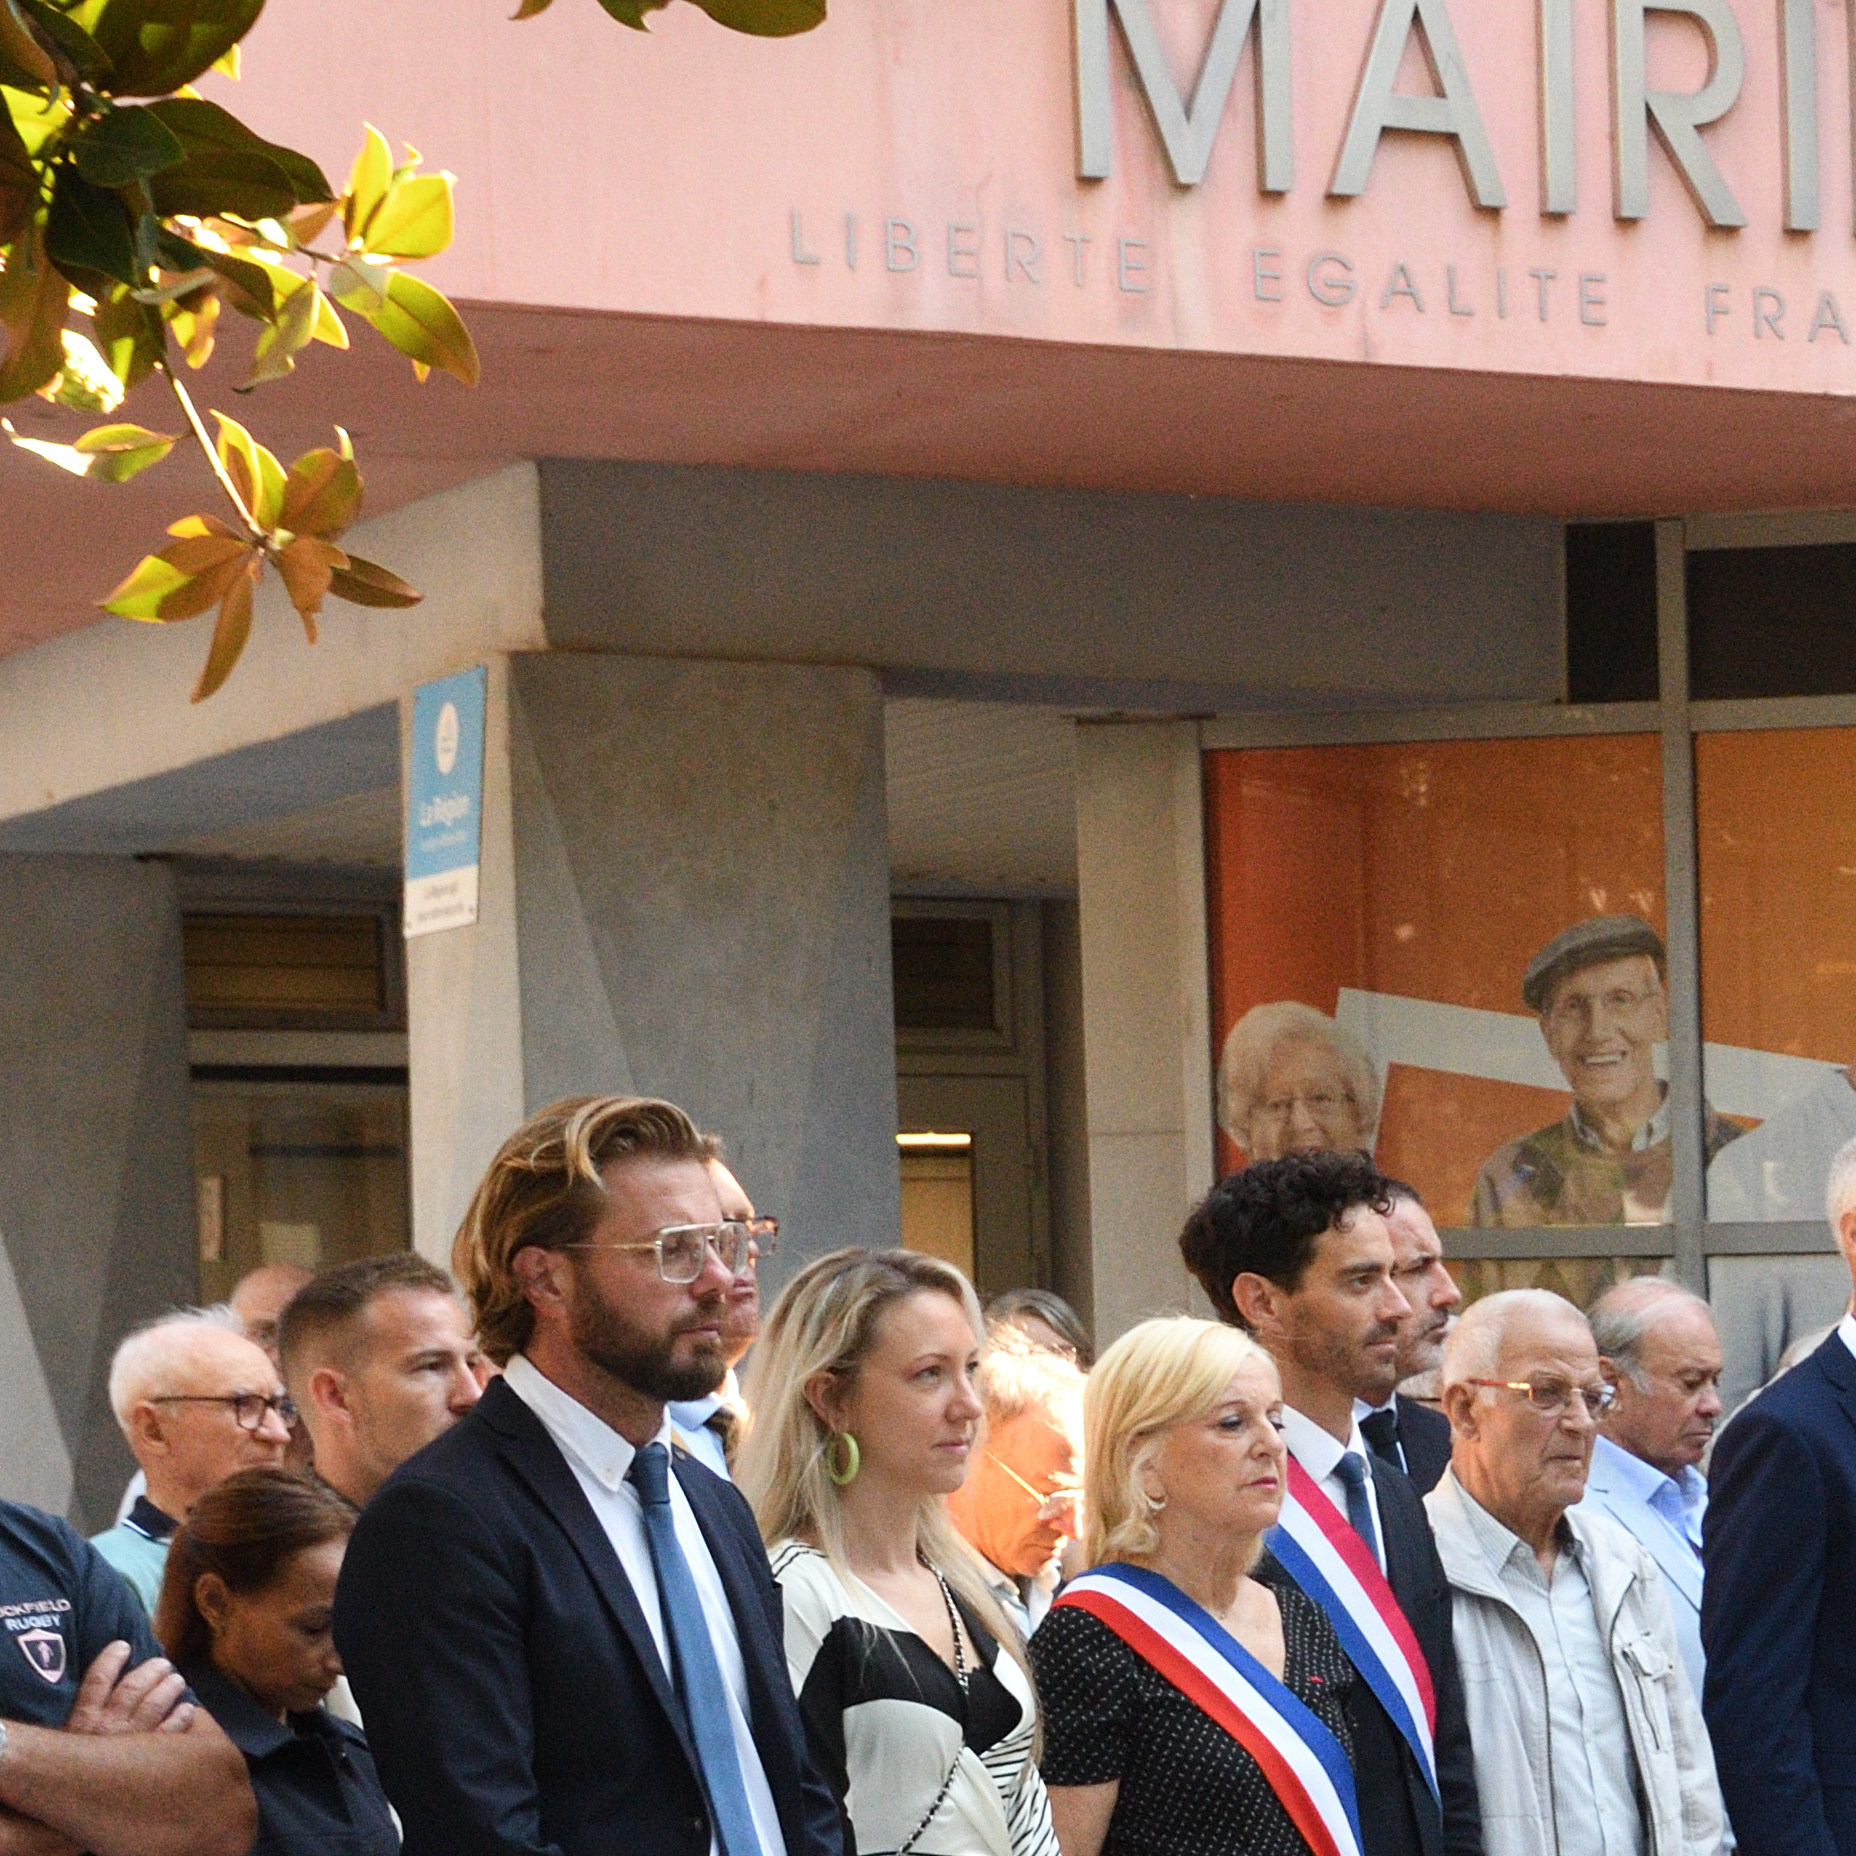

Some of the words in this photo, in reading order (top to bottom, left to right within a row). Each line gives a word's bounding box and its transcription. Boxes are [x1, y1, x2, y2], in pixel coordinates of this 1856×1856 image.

[788, 208, 1151, 297] LIBERTE
[1250, 246, 1609, 329] EGALITE
[5, 1613, 61, 1631] RUGBY
